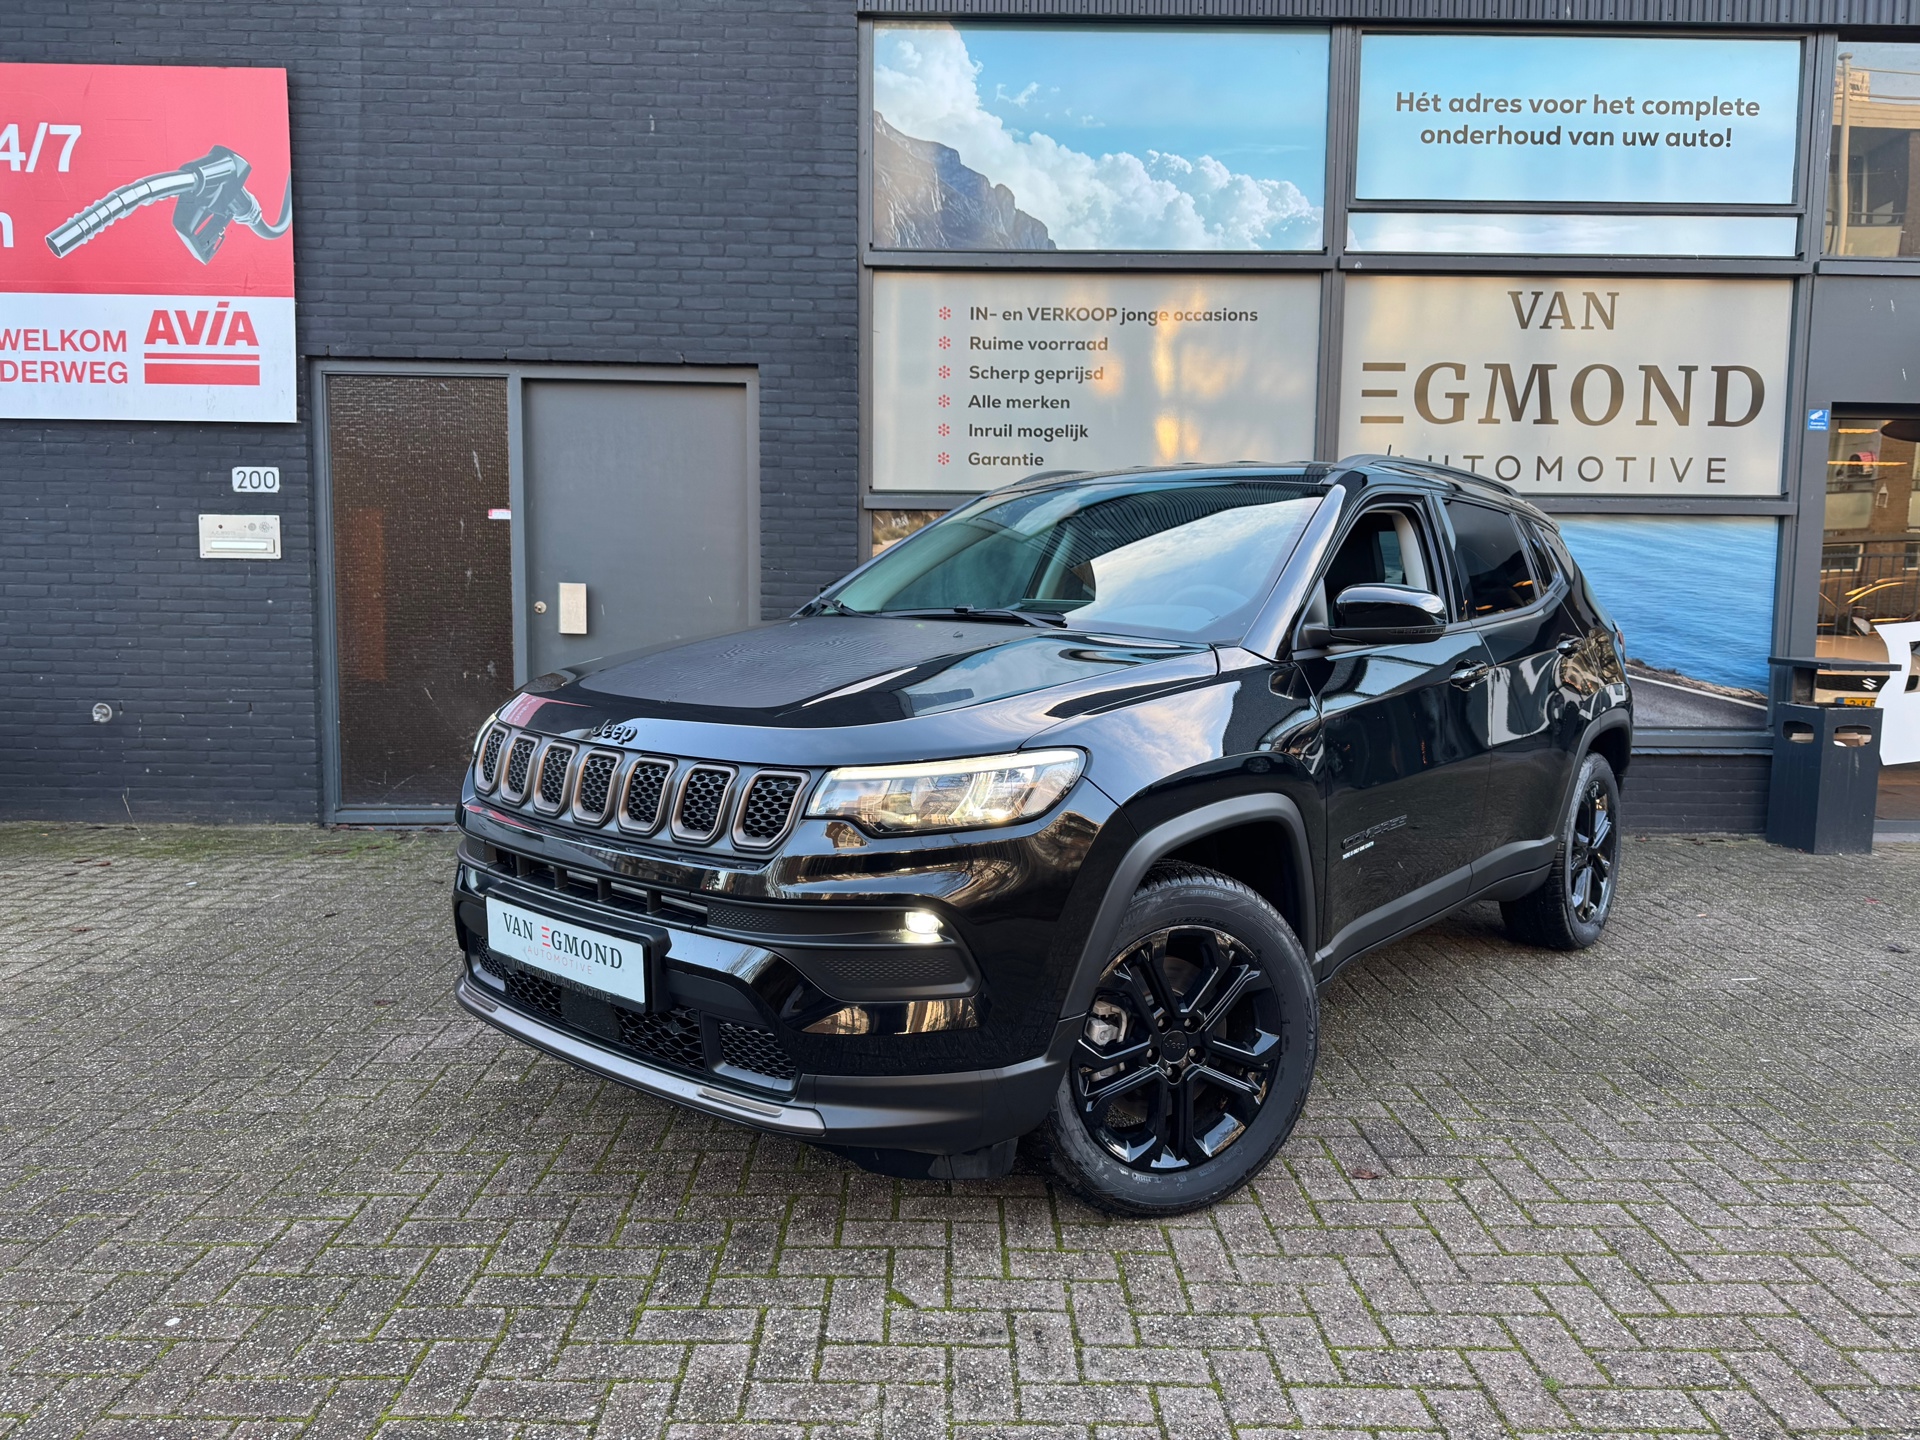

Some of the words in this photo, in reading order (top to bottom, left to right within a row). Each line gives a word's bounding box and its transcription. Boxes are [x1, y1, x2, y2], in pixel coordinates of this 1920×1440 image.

[1396, 91, 1441, 112] Hét
[1449, 92, 1522, 113] adres
[1528, 98, 1587, 114] voor
[1593, 94, 1635, 115] het
[1641, 95, 1760, 122] complete
[1420, 124, 1561, 145] onderhoud
[1568, 131, 1614, 146] van
[1622, 131, 1659, 147] uw
[1665, 127, 1732, 148] auto!
[969, 306, 998, 321] IN-
[1002, 309, 1023, 321] en
[1027, 306, 1118, 322] VERKOOP
[1119, 307, 1169, 327] jonge
[1173, 307, 1258, 322] occasions
[1507, 290, 1620, 331] VAN
[0, 328, 127, 353] WELKOM
[969, 336, 1024, 351] Ruime
[1028, 336, 1109, 351] voorraad
[0, 360, 128, 384] DERWEG
[969, 365, 1030, 384] Scherp
[1034, 366, 1104, 385] geprijsd
[968, 394, 1001, 409] Alle
[1006, 395, 1070, 409] merken
[1360, 361, 1766, 428] EGMOND
[968, 423, 1013, 438] Inruil
[1017, 424, 1089, 443] mogelijk
[968, 451, 1044, 466] Garantie
[1400, 454, 1728, 484] TOMOTIVE
[236, 470, 276, 489] 200
[590, 718, 638, 745] Jeep
[503, 911, 534, 942] VAN
[541, 925, 623, 969] EGMOND
[527, 945, 593, 975] AUTOMOTIVE
[560, 974, 612, 1001] AUTOMOTIVE
